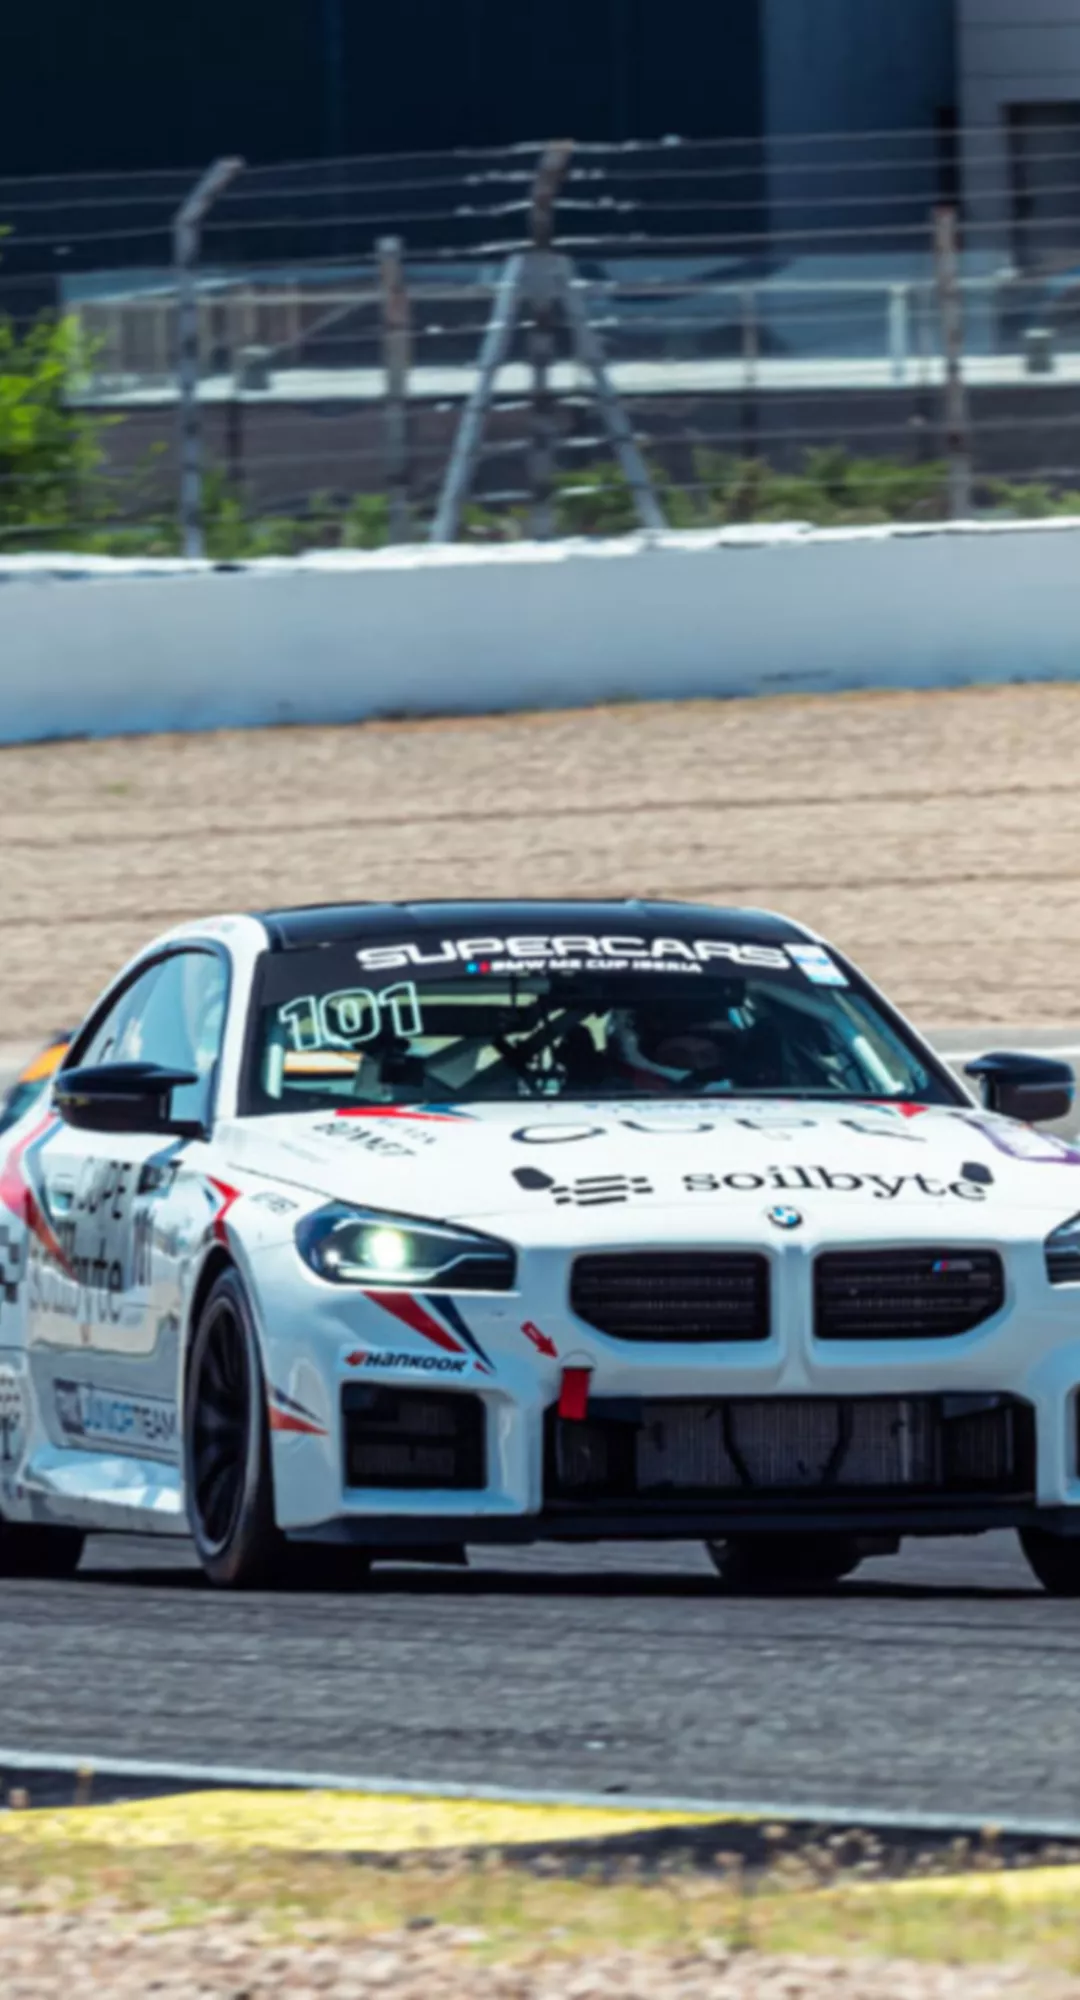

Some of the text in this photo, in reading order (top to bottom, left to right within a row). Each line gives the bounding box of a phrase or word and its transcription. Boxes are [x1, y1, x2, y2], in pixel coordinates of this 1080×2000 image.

[356, 936, 791, 970] SUPERCARS
[491, 959, 545, 971] BMW
[585, 960, 629, 971] CUP
[631, 960, 703, 973] IBERIA
[278, 982, 424, 1050] 101
[682, 1165, 989, 1201] soilbyte
